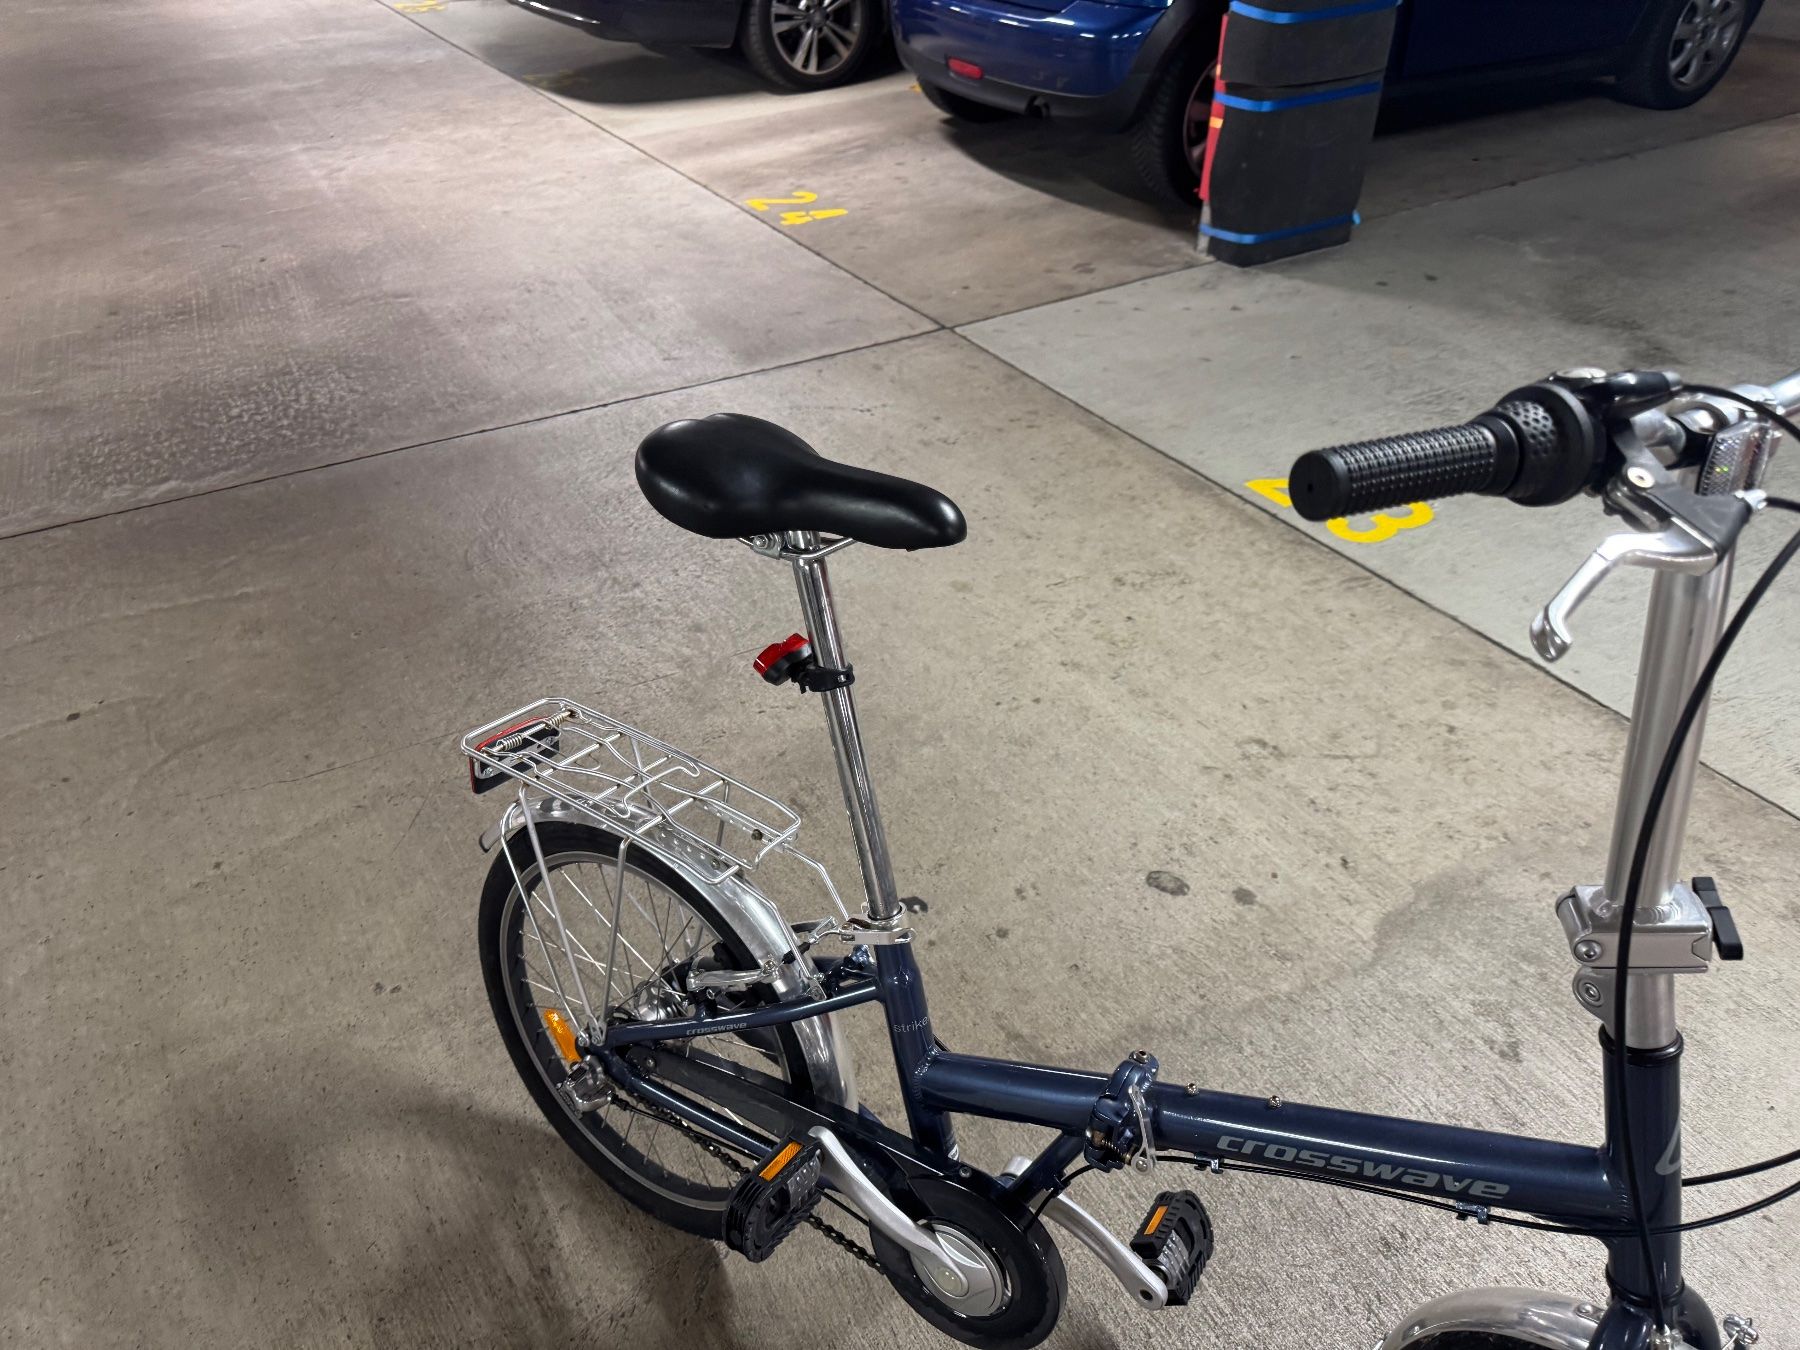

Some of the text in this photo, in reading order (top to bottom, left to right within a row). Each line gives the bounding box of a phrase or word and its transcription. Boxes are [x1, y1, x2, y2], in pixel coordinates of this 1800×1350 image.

[744, 190, 848, 227] 24
[686, 1022, 747, 1036] crosswave
[1216, 1134, 1510, 1200] crosswave
